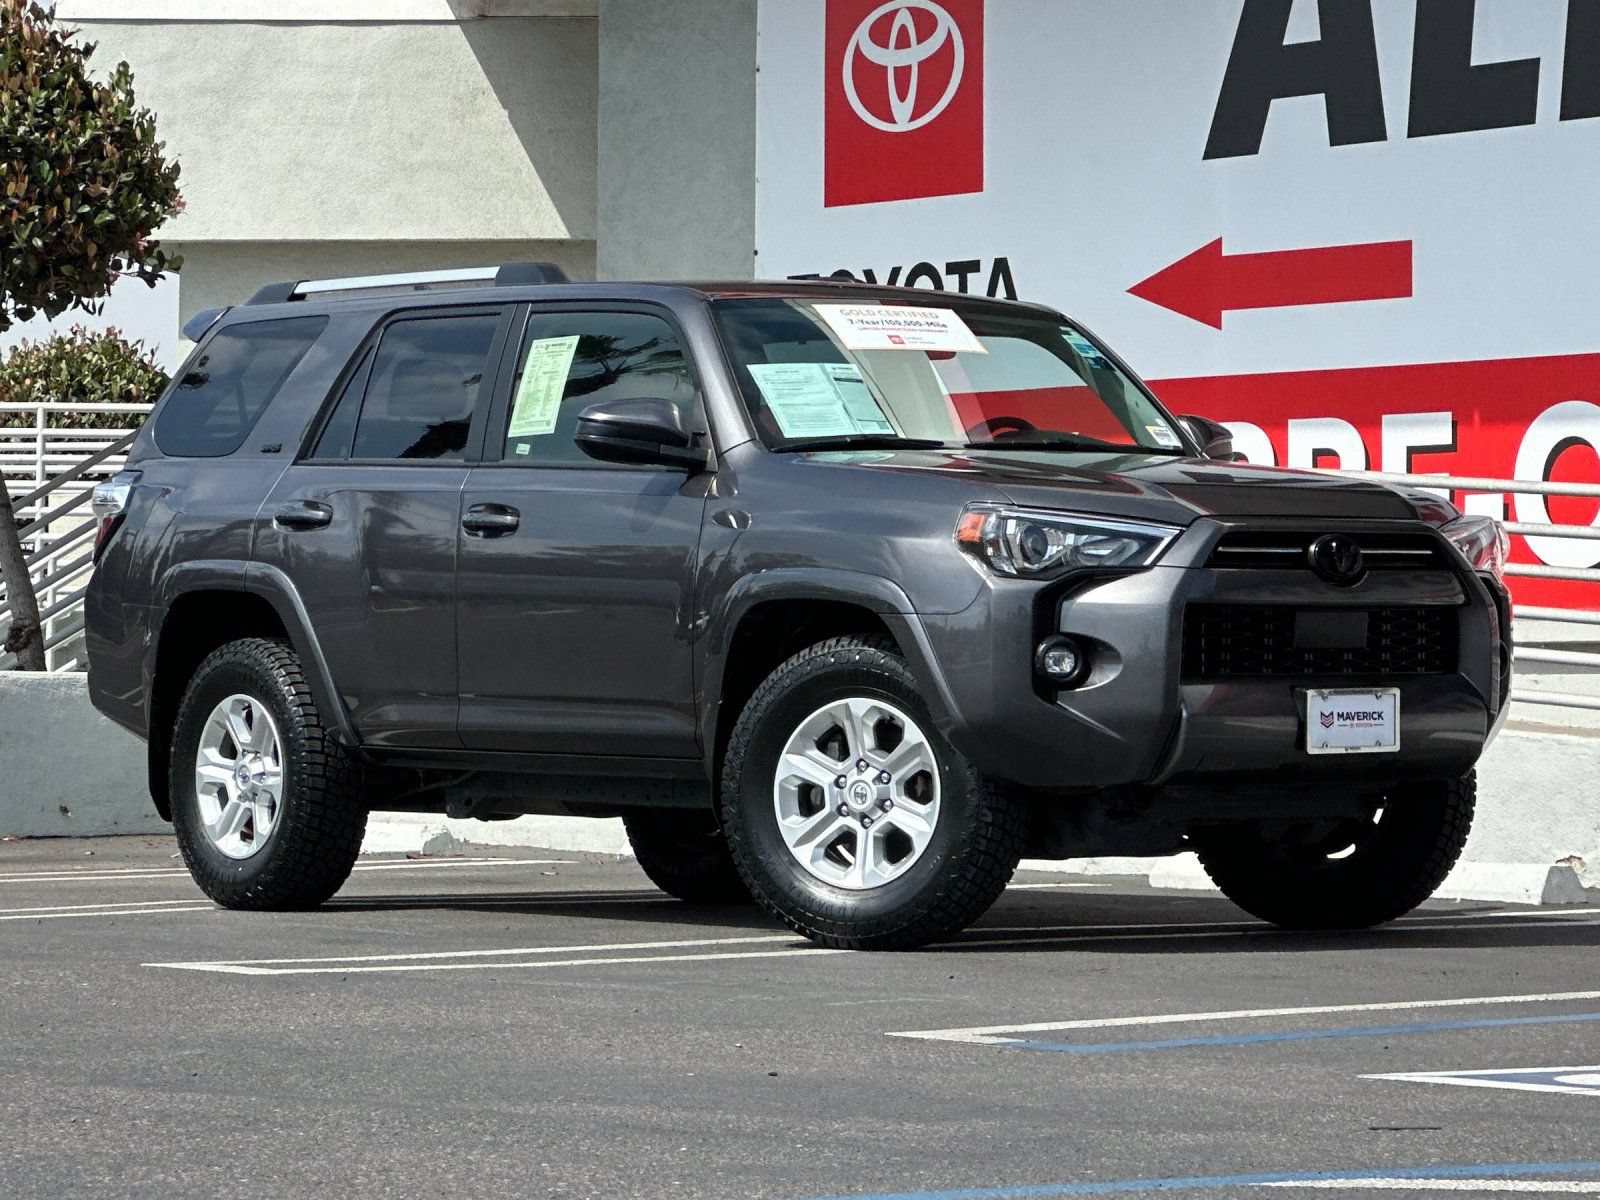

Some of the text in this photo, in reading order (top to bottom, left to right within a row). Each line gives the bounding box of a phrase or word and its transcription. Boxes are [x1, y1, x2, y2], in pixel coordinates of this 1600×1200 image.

[787, 256, 1018, 301] OTA
[839, 308, 939, 319] GOLD CERTIFIED
[1337, 711, 1384, 721] MAVERICK
